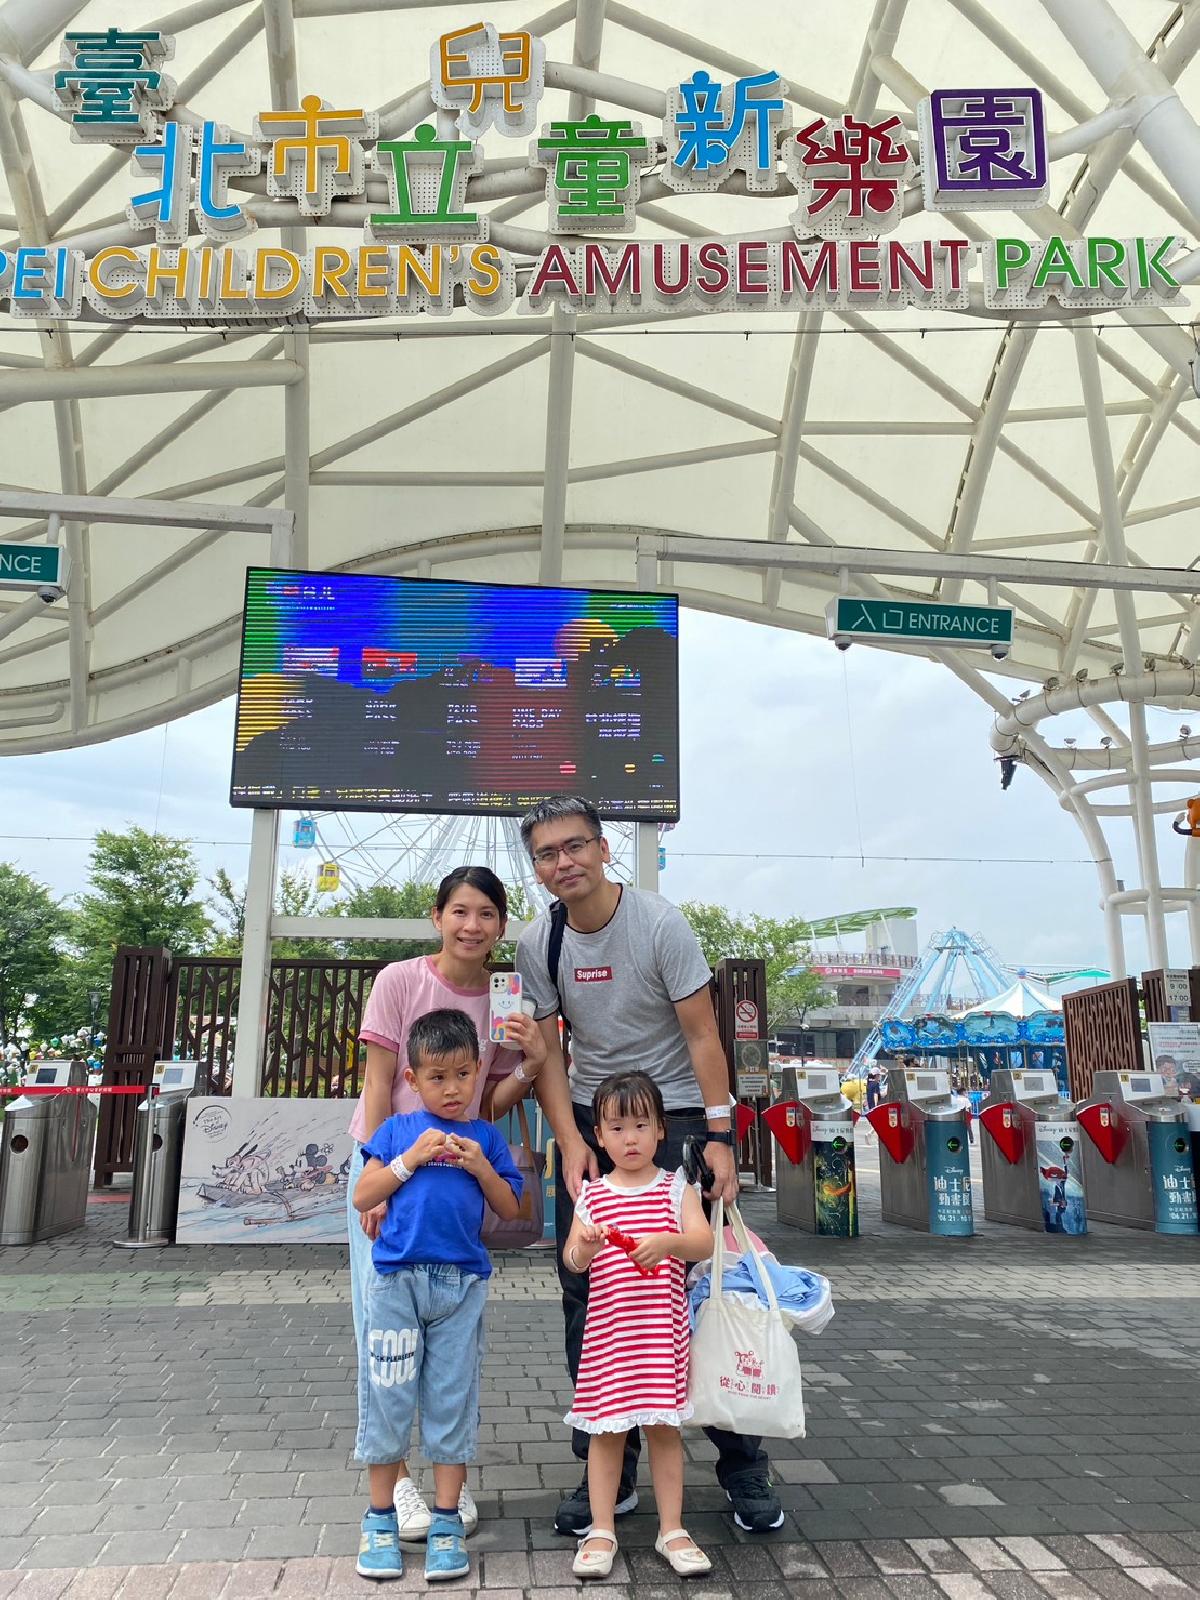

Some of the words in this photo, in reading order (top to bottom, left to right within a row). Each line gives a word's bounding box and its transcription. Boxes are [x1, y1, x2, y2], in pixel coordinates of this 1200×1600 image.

[0, 246, 68, 299] EI
[88, 245, 501, 299] CHILDREN'S
[532, 238, 969, 297] AMUSEMENT
[995, 235, 1180, 289] PARK
[851, 604, 903, 631] 入口
[909, 612, 999, 634] ENTRANCE
[577, 969, 608, 981] Suprise
